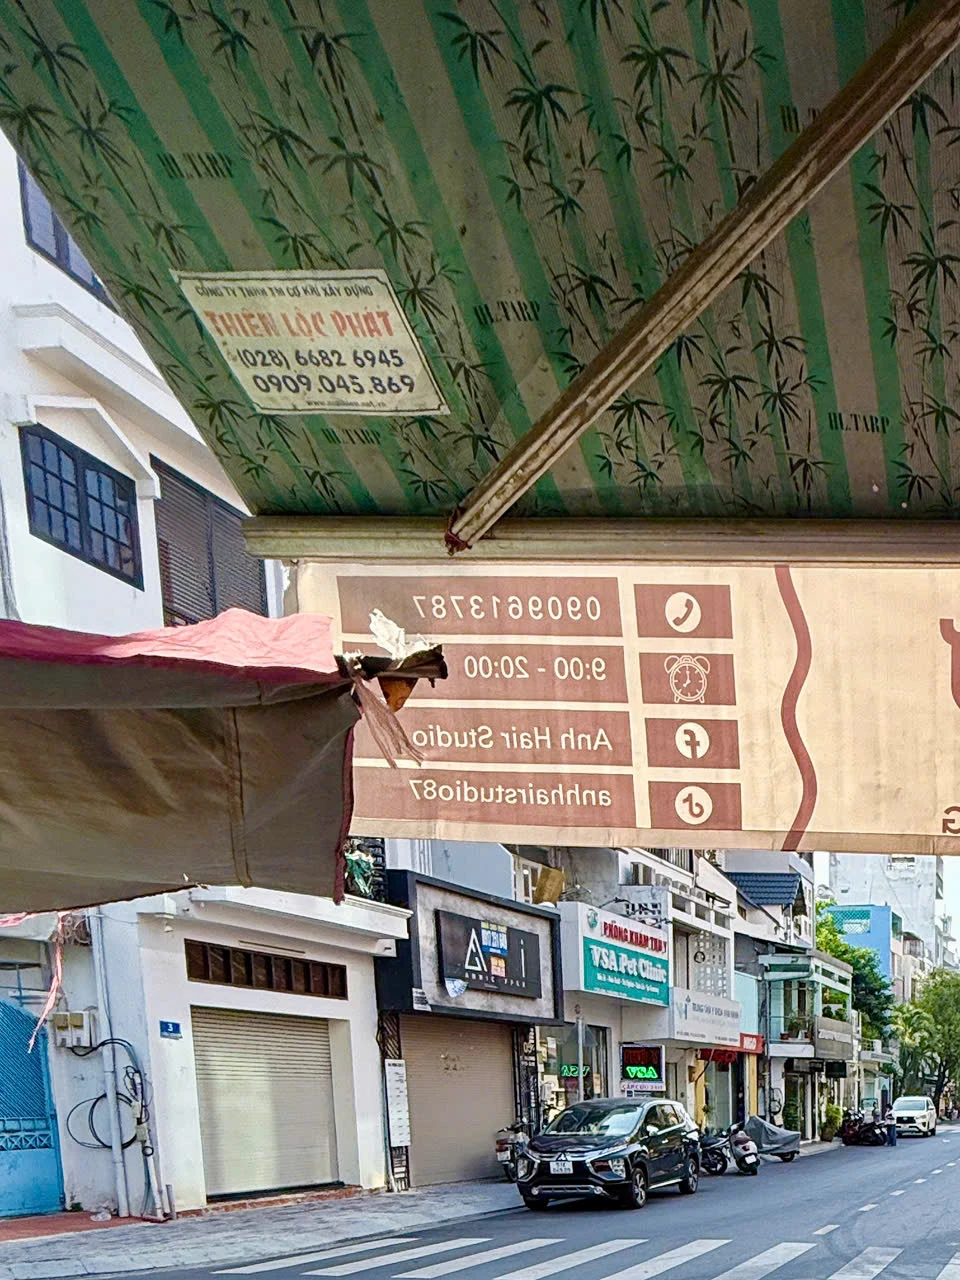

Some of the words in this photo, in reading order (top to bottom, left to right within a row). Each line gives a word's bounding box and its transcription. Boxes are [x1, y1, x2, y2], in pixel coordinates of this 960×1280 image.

[280, 306, 328, 343] LỘC
[236, 349, 289, 369] (028)
[295, 349, 347, 368] 6682
[353, 349, 404, 368] 6945
[252, 373, 415, 395] 0909.045.869
[590, 944, 618, 973] VSA
[618, 952, 638, 977] Pet
[638, 957, 667, 984] Clinic
[167, 1023, 174, 1032] 3
[626, 1065, 659, 1079] VSA
